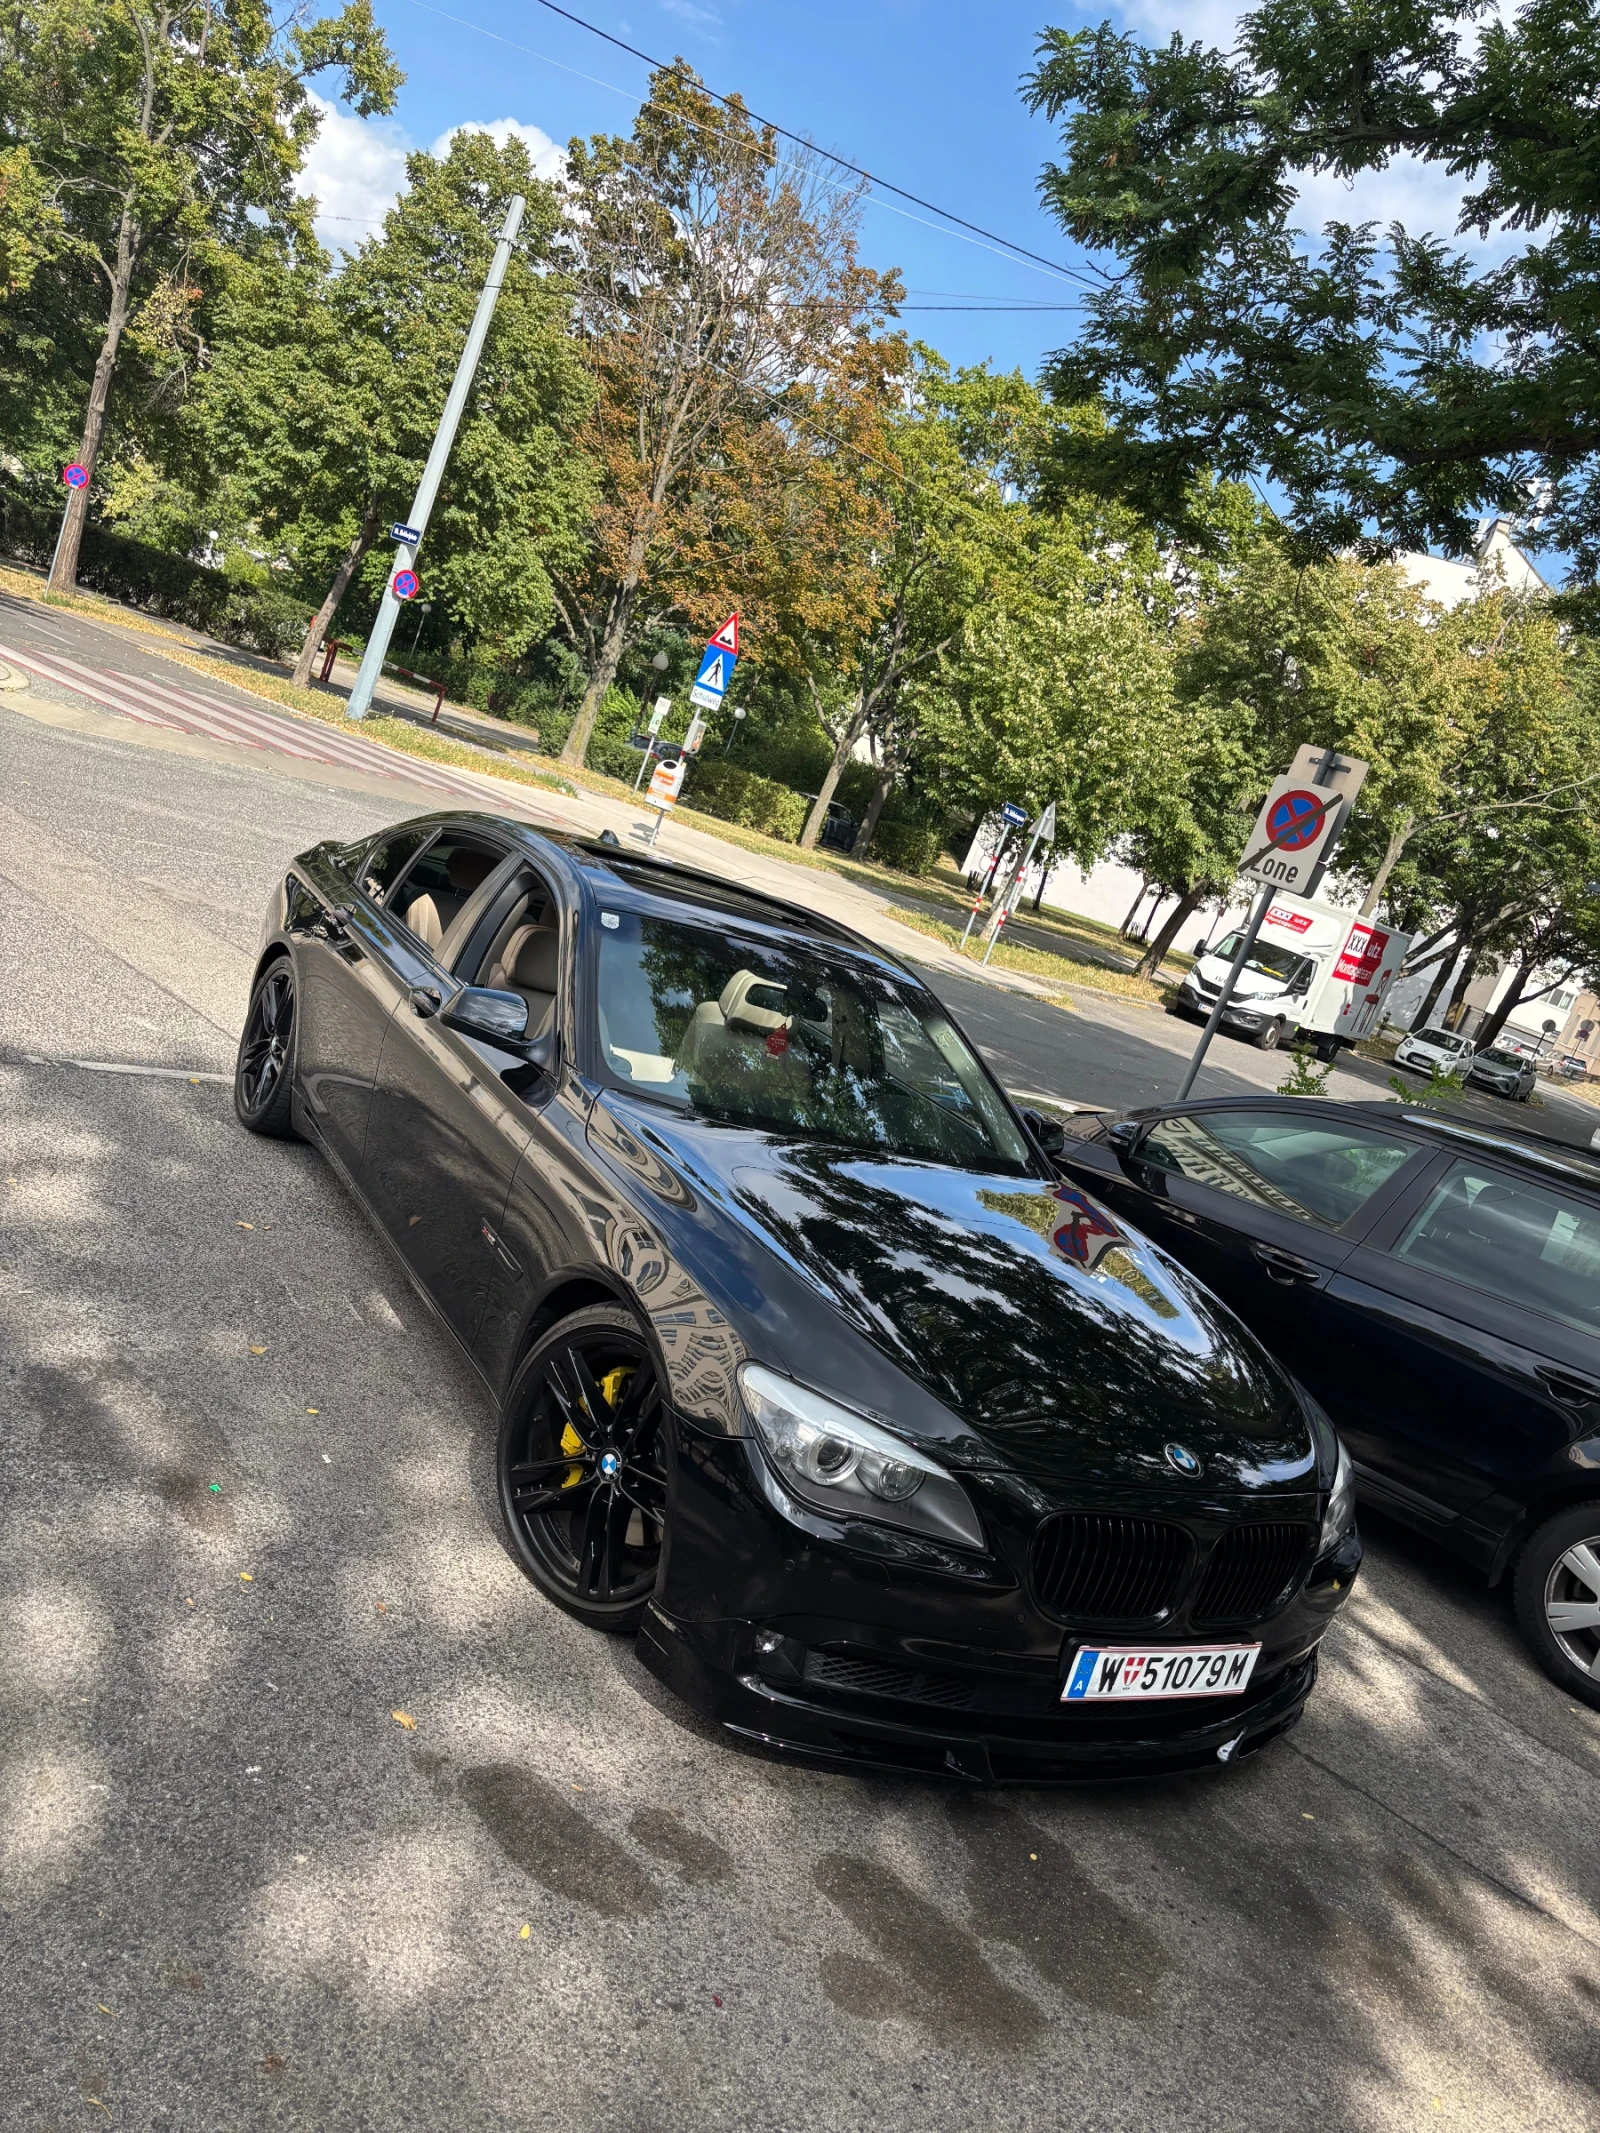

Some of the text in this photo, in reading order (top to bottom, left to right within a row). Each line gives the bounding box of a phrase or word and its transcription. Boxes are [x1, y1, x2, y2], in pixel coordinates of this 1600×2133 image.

[692, 688, 720, 708] Schulweg
[1098, 1656, 1126, 1692] W
[1073, 1680, 1083, 1691] A
